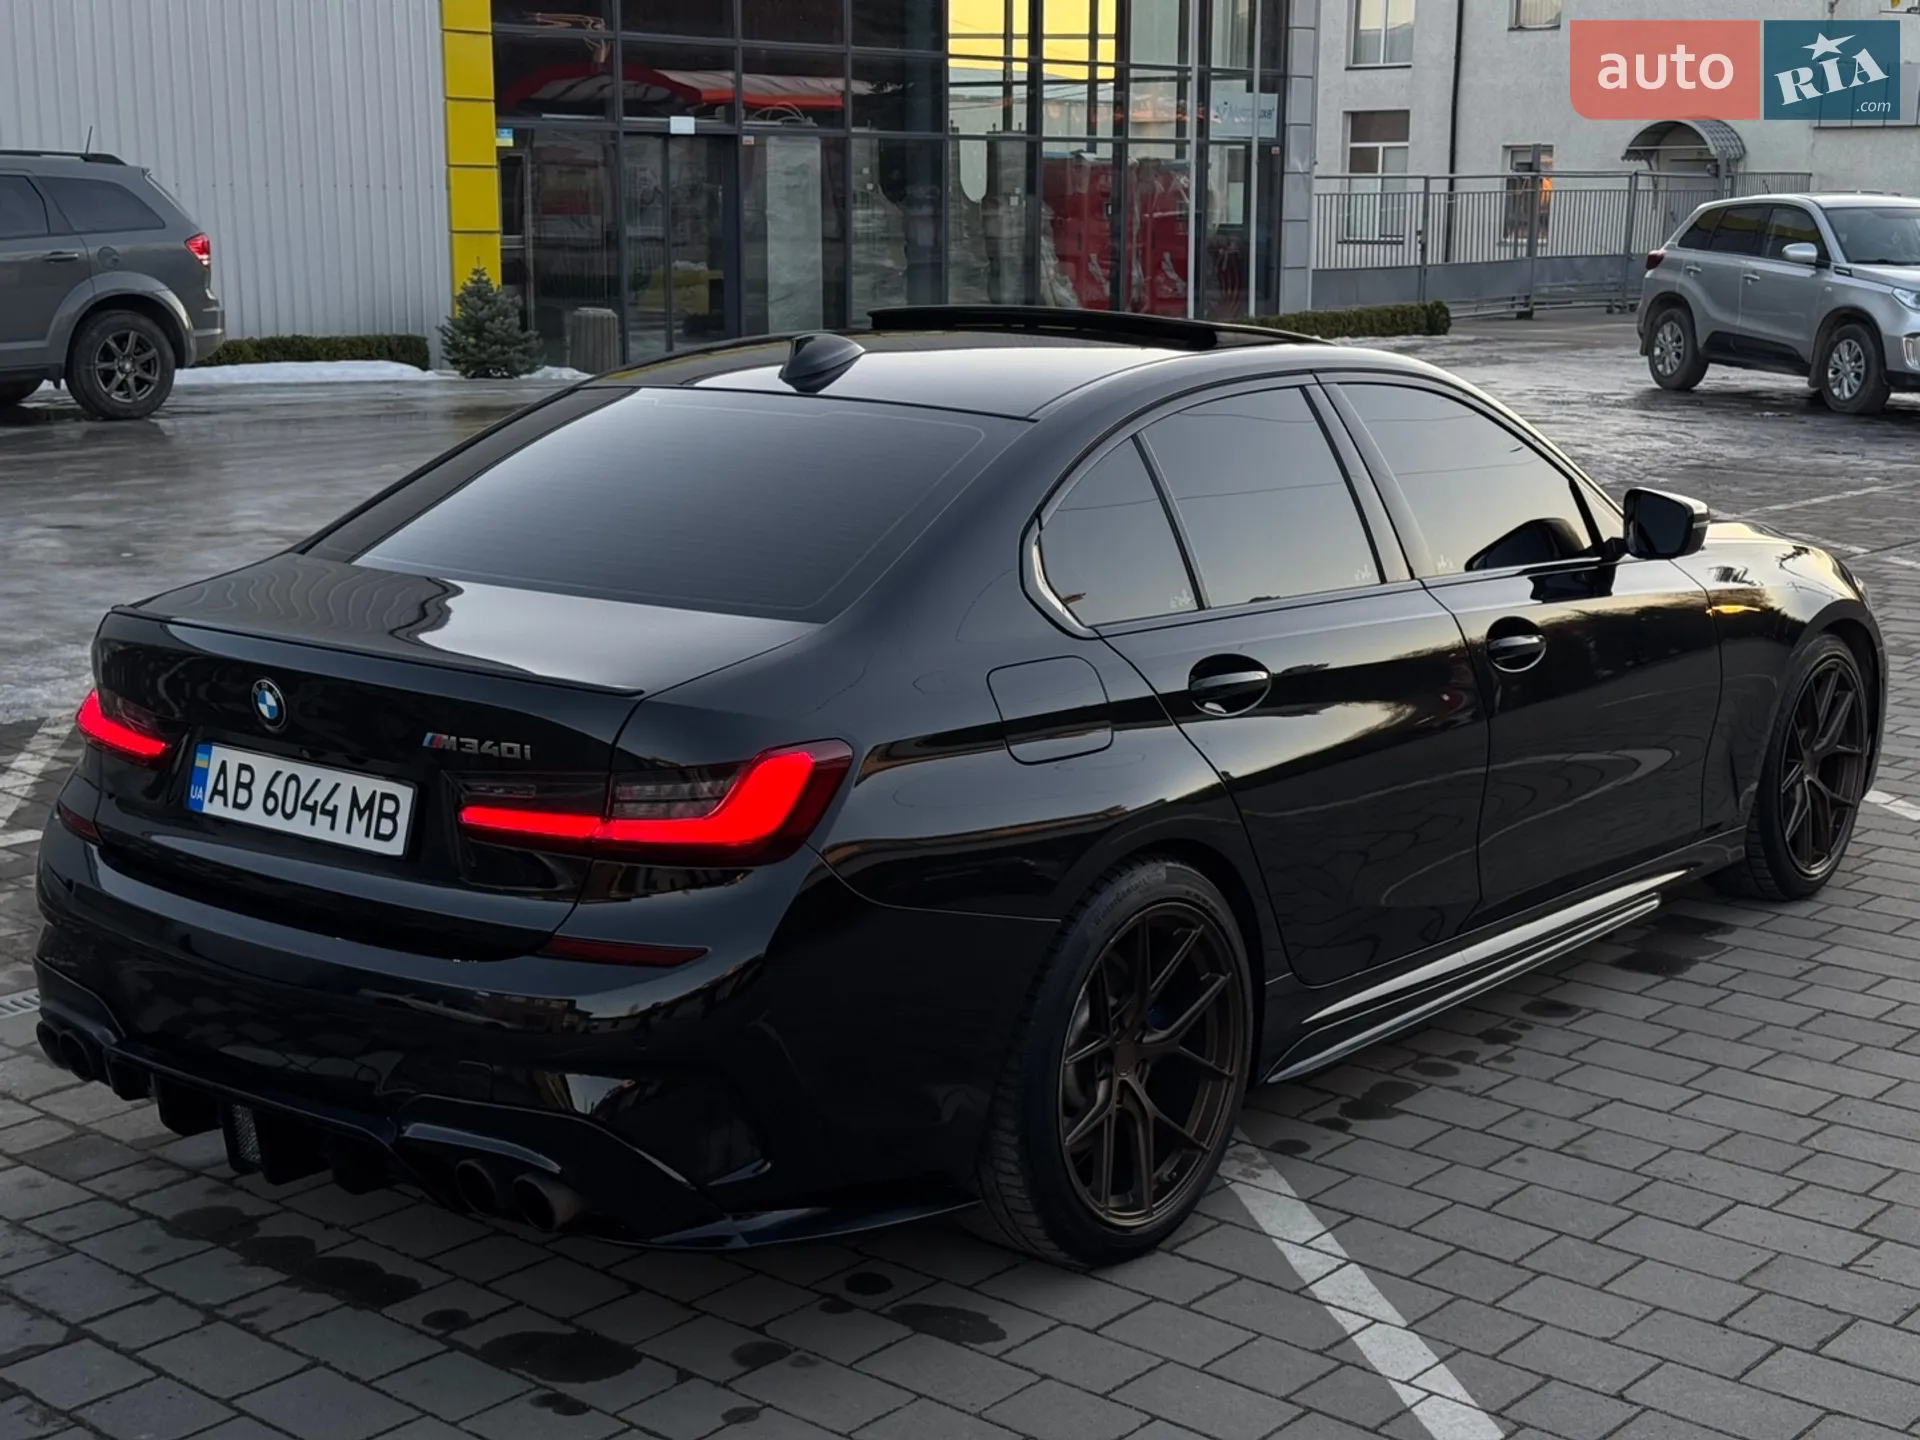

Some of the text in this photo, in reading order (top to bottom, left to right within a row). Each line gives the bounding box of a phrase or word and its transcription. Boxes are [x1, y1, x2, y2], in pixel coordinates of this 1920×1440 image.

[435, 733, 532, 761] M340i
[190, 784, 204, 801] UA
[208, 759, 401, 842] AB 6044 MB
